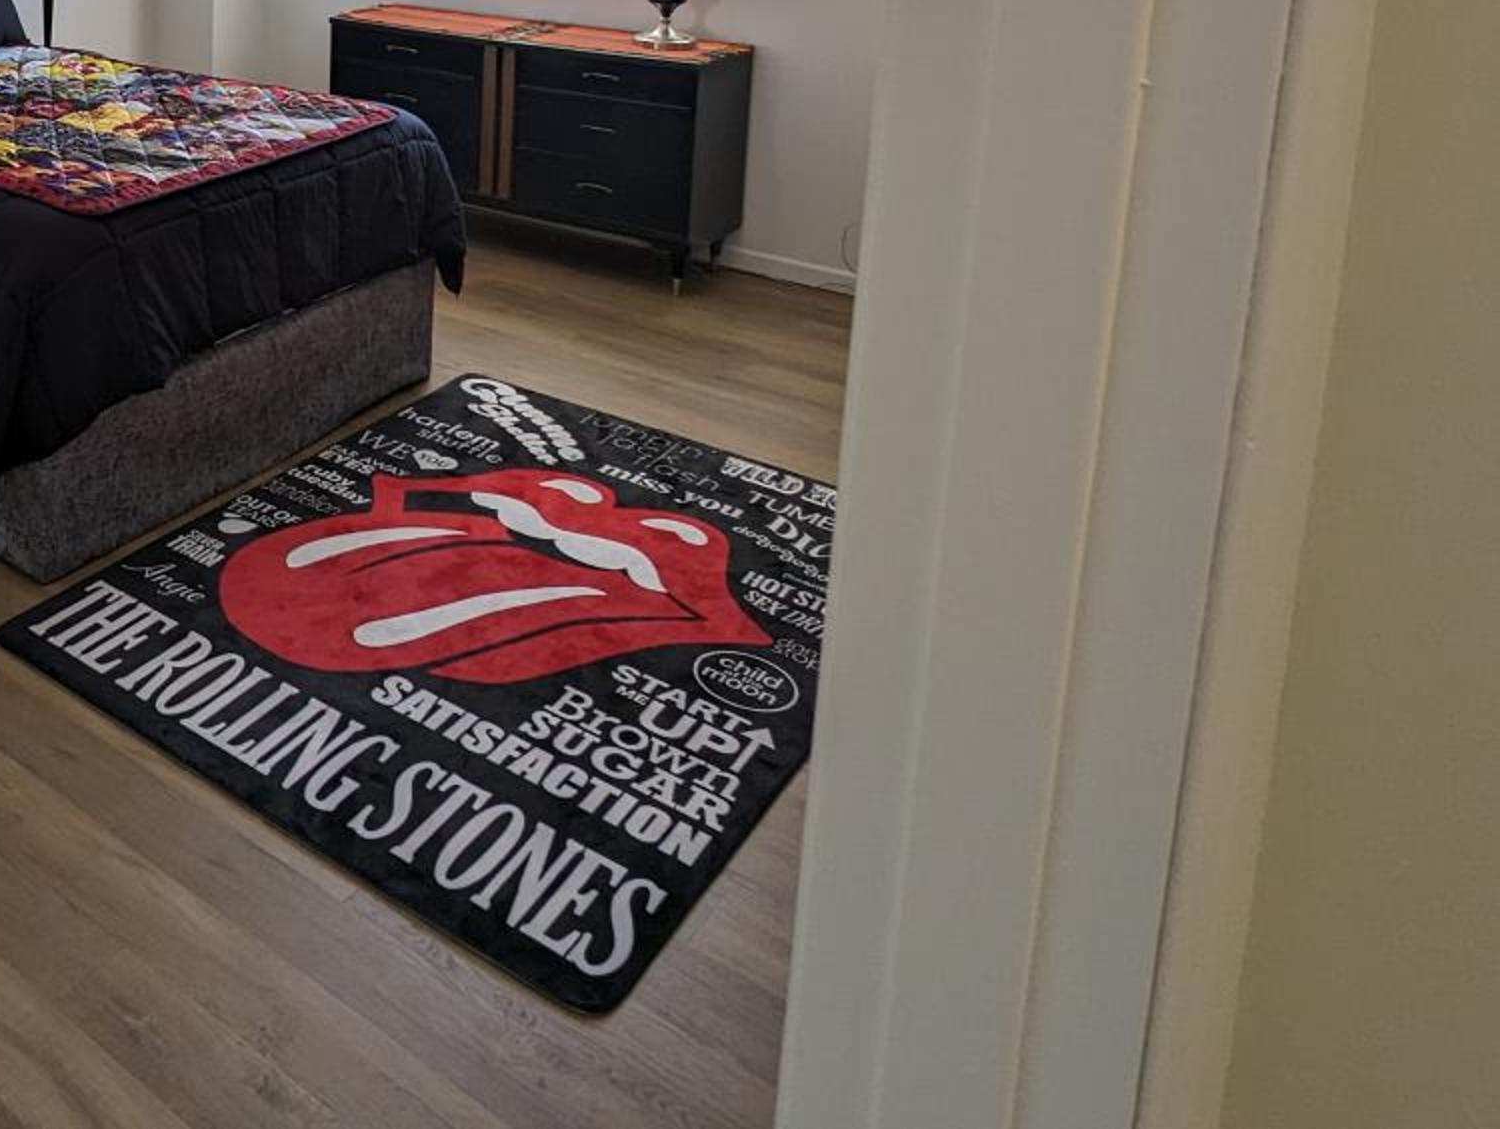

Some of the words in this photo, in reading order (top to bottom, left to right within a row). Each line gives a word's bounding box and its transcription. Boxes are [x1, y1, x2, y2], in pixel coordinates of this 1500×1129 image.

[358, 430, 417, 461] WE
[400, 407, 501, 451] harlem
[417, 429, 503, 464] shuffle
[302, 463, 357, 487] ruby
[597, 463, 674, 496] miss
[674, 490, 747, 520] you
[720, 456, 806, 496] WILD
[236, 494, 277, 515] OUT
[165, 532, 226, 568] TRAIN
[120, 562, 207, 605] Angie
[740, 570, 797, 600] HOT
[743, 589, 790, 616] SEX
[701, 665, 778, 706] moon
[719, 657, 785, 690] child
[610, 663, 754, 730] START
[615, 685, 651, 707] ME
[544, 684, 742, 803] Brown
[28, 578, 180, 675] THE
[115, 629, 401, 813] ROLLING
[346, 760, 669, 977] STONES
[370, 674, 715, 868] SATISFACTION
[518, 709, 734, 834] SUGAR
